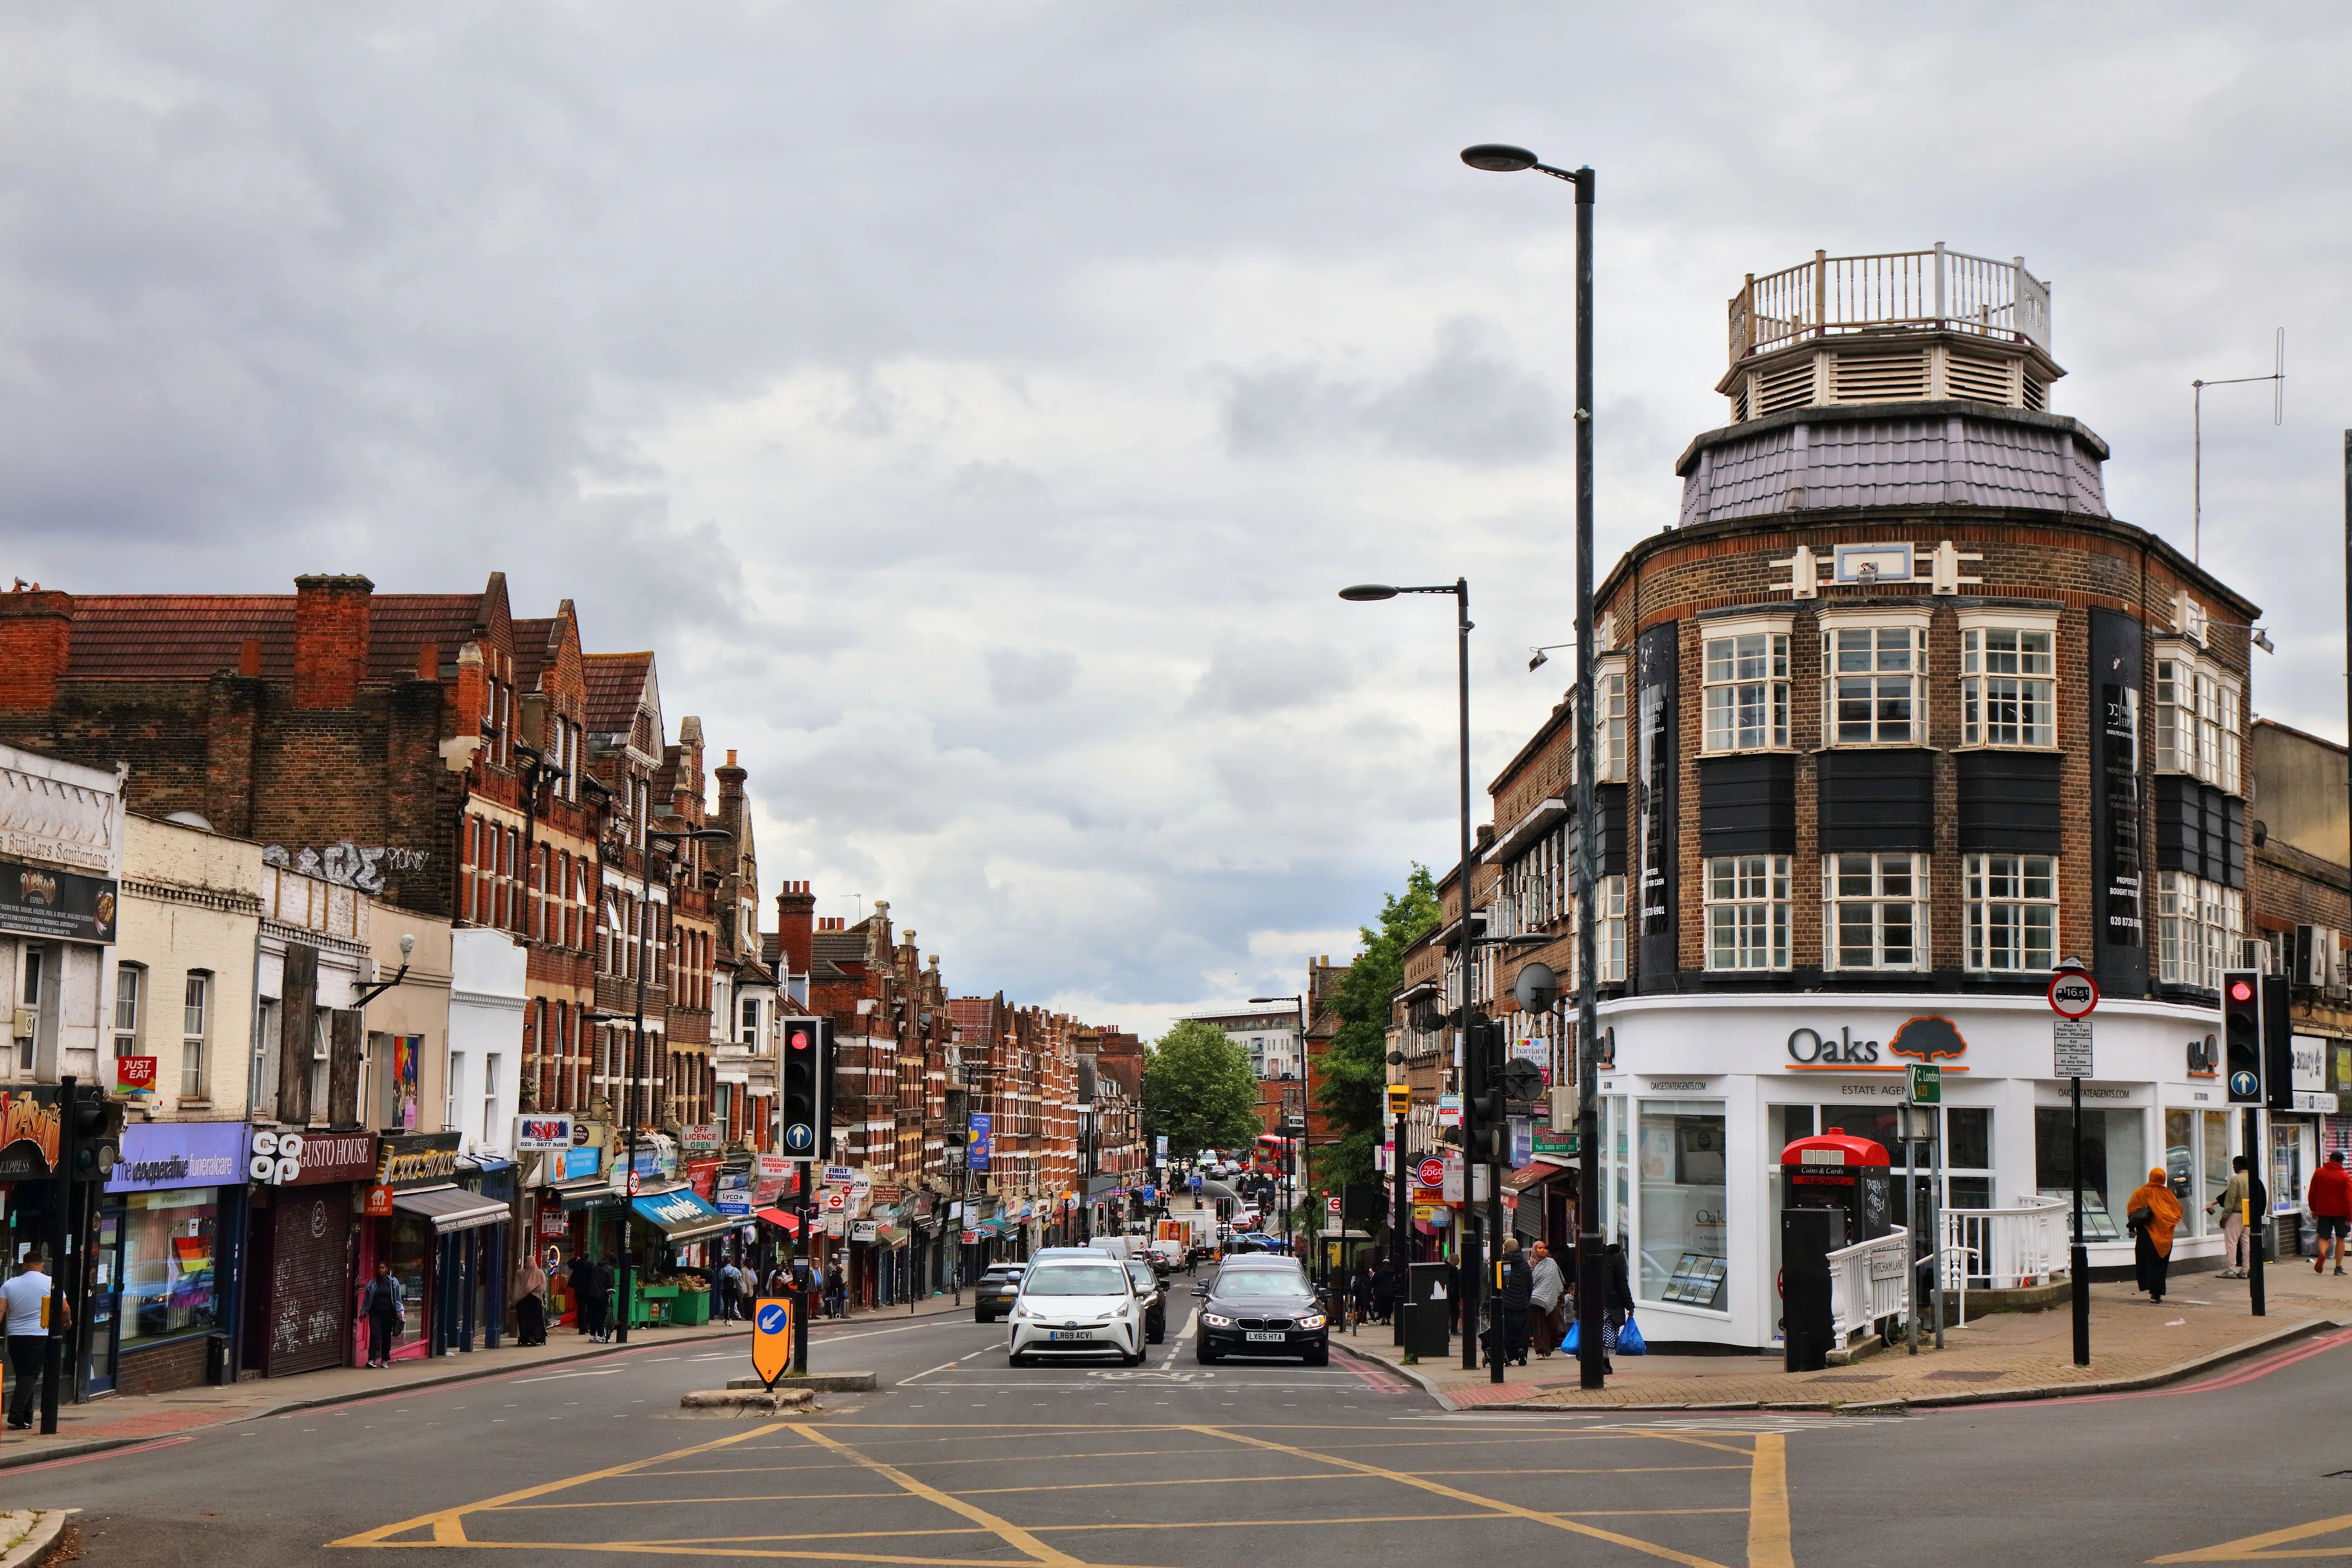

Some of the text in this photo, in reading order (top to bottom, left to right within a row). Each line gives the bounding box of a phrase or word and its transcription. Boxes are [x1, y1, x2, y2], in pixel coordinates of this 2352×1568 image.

[9, 833, 52, 857] Builders
[56, 842, 108, 868] Sanitarians
[1654, 878, 1664, 886] CASH
[2116, 876, 2138, 886] PROPERTIES
[2110, 887, 2127, 896] BOUGHT
[30, 896, 44, 904] EXPRESS
[1654, 905, 1665, 916] 6901
[1, 921, 23, 930] CELEBRATIONS
[60, 920, 75, 929] BIRTHDAYS
[2110, 916, 2133, 927] 020 8720
[2066, 988, 2083, 997] 16.5
[1787, 1026, 1878, 1063] Oaks
[1516, 1046, 1546, 1055] barnard
[124, 1060, 151, 1071] JUST
[129, 1070, 151, 1079] EAT
[1917, 1070, 1939, 1083] C. London
[1650, 1082, 1706, 1090] OAKSESTATEAGENTS.COM
[1842, 1085, 1906, 1095] ESTATE AGEN
[1918, 1085, 1928, 1097] A23
[2058, 1088, 2129, 1099] OAKSTATEAGENTS.COM
[529, 1121, 560, 1141] SAB
[299, 1138, 369, 1169] GUSTO HOUSE
[189, 1153, 232, 1177] funeralcare
[390, 1151, 460, 1183] CAKE HOUSE
[631, 1177, 638, 1188] 20
[854, 1223, 875, 1233] Grillo's
[1873, 1259, 1903, 1273] MITCHAM LANE
